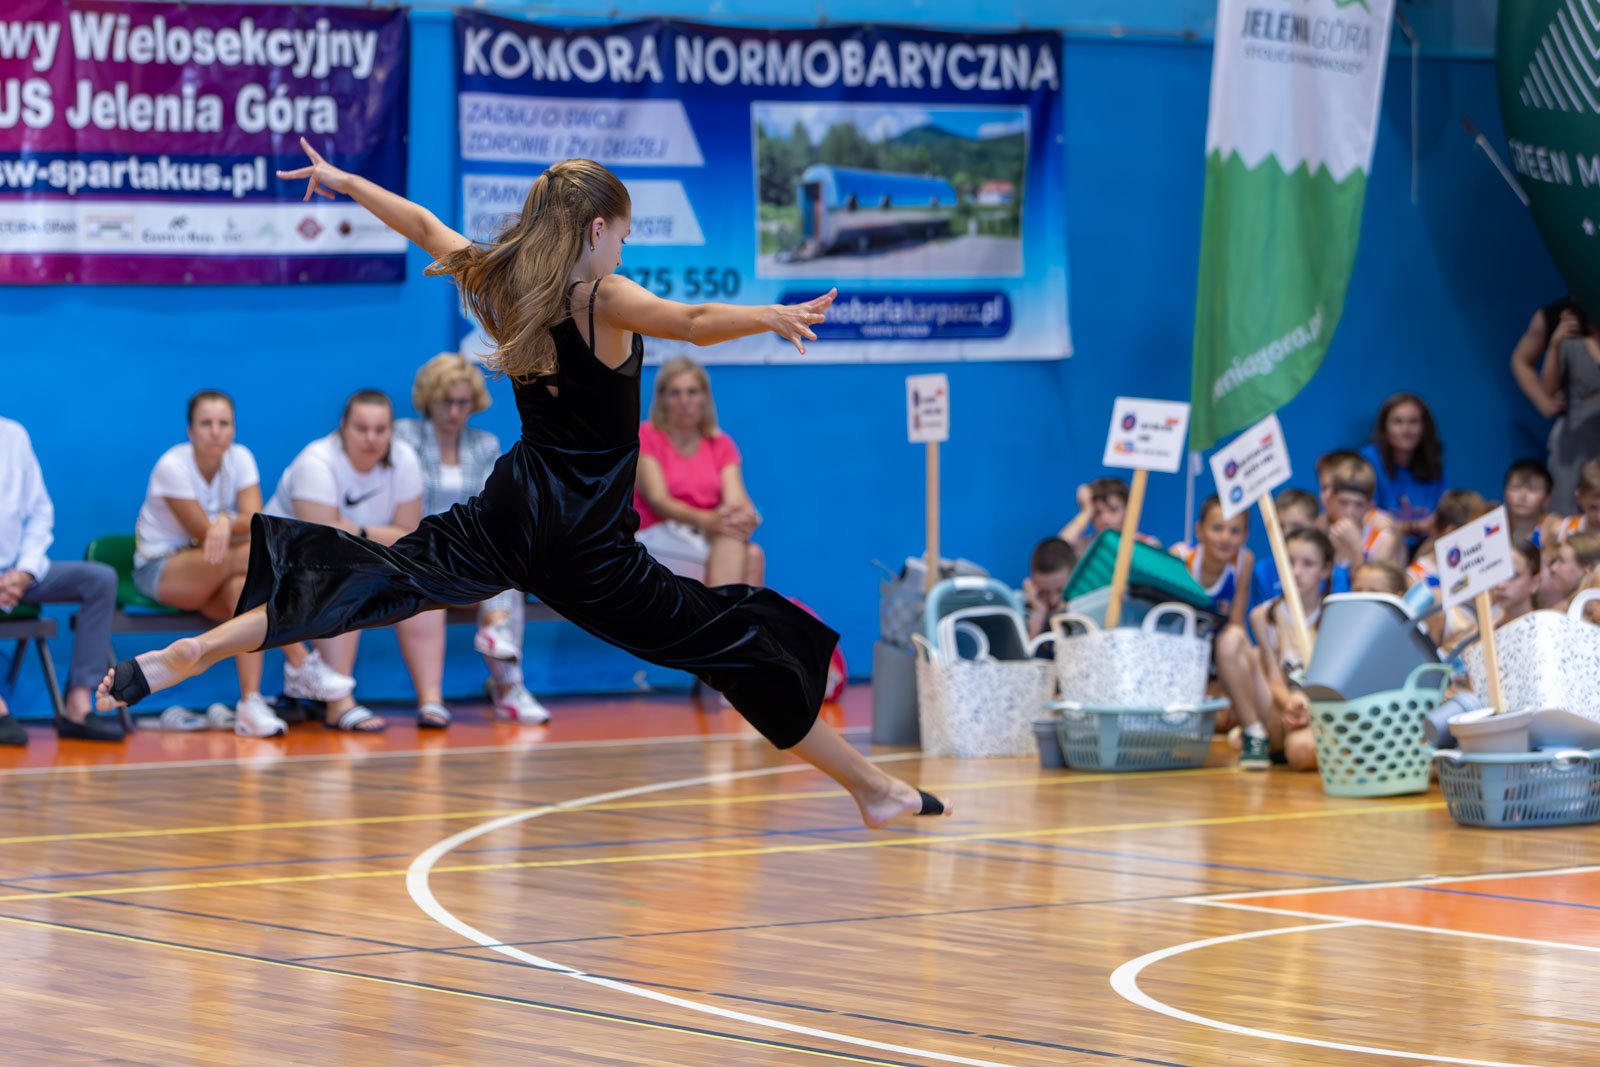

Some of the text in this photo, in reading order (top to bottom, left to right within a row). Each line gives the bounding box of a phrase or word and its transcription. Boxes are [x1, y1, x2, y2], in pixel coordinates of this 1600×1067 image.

[69, 10, 379, 80] Wielosekcyjny
[463, 27, 1060, 92] KOMORA NORMOBARYCZNA
[65, 79, 224, 133] Jelenia
[235, 83, 339, 134] Góra
[615, 266, 742, 299] 75 550
